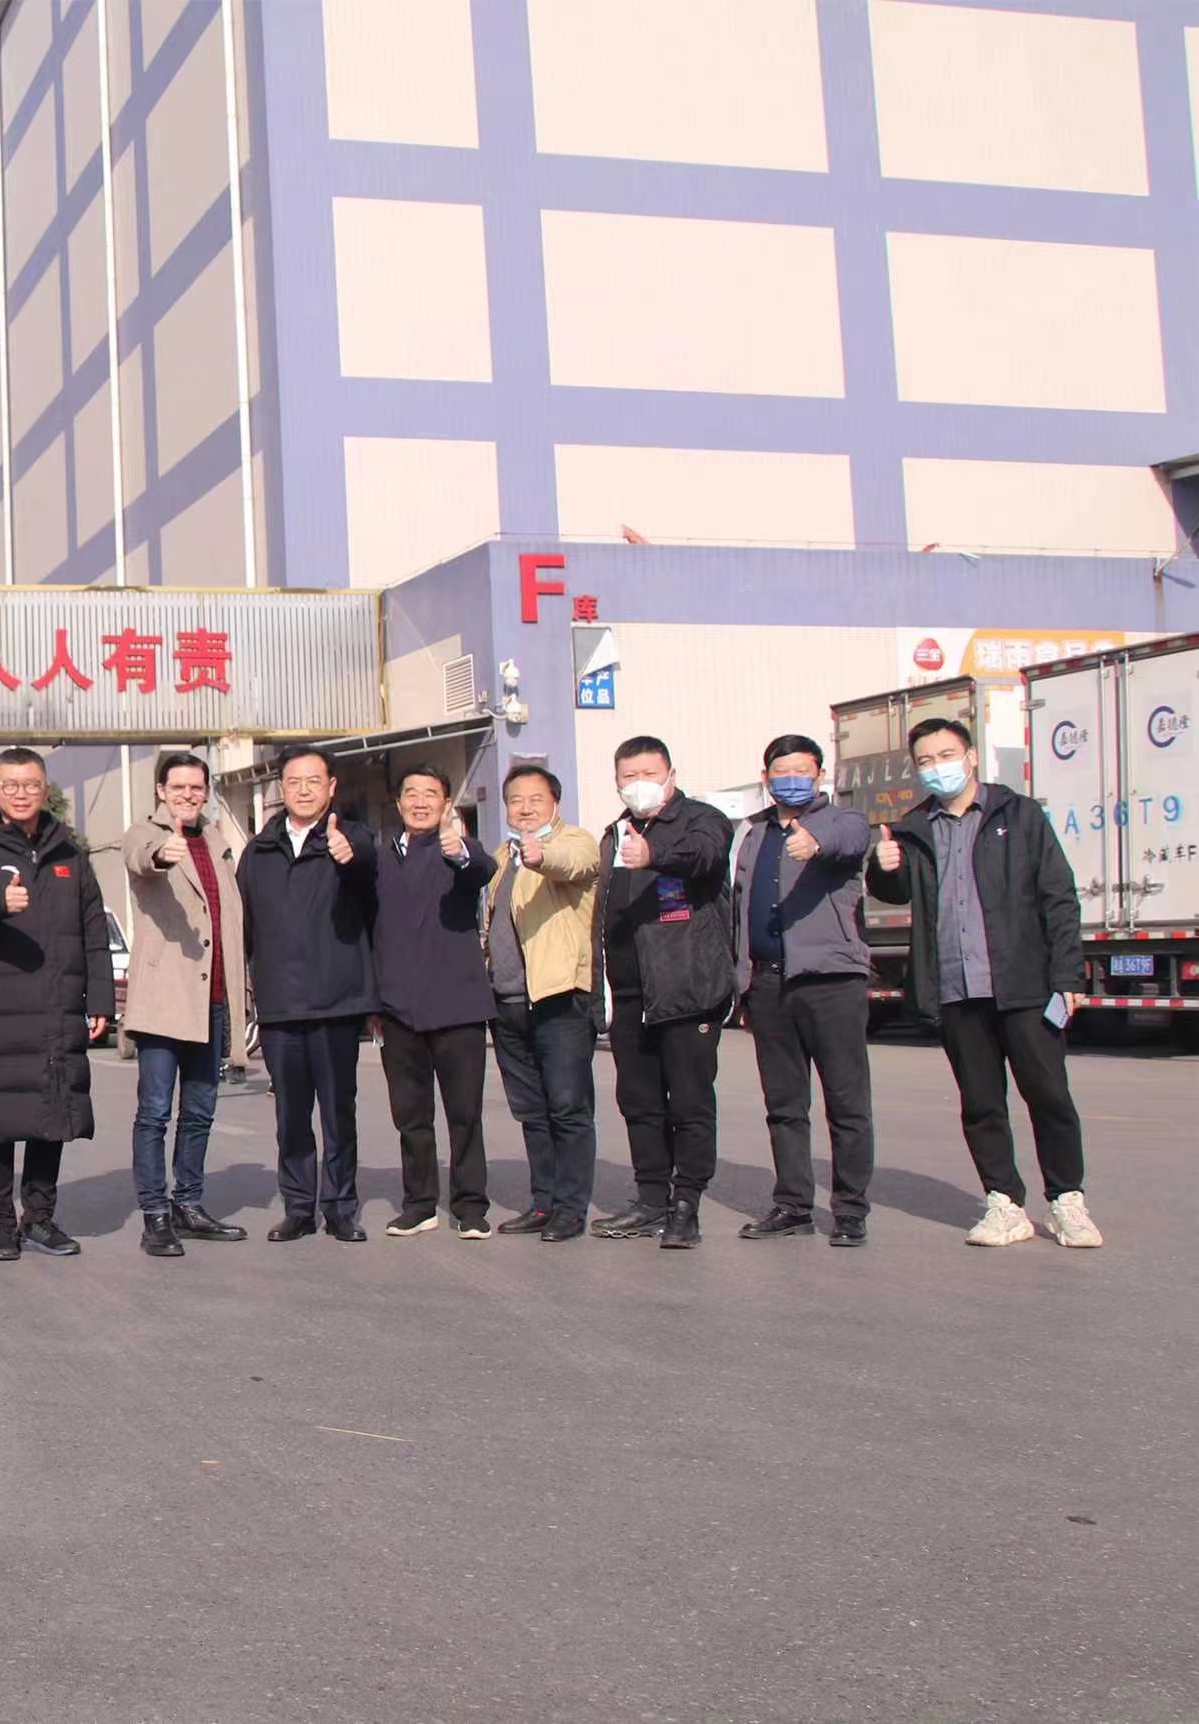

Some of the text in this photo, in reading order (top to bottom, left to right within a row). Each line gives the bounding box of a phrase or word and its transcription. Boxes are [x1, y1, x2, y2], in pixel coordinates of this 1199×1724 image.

[520, 554, 599, 624] F 库
[1044, 795, 1184, 841] A36T9
